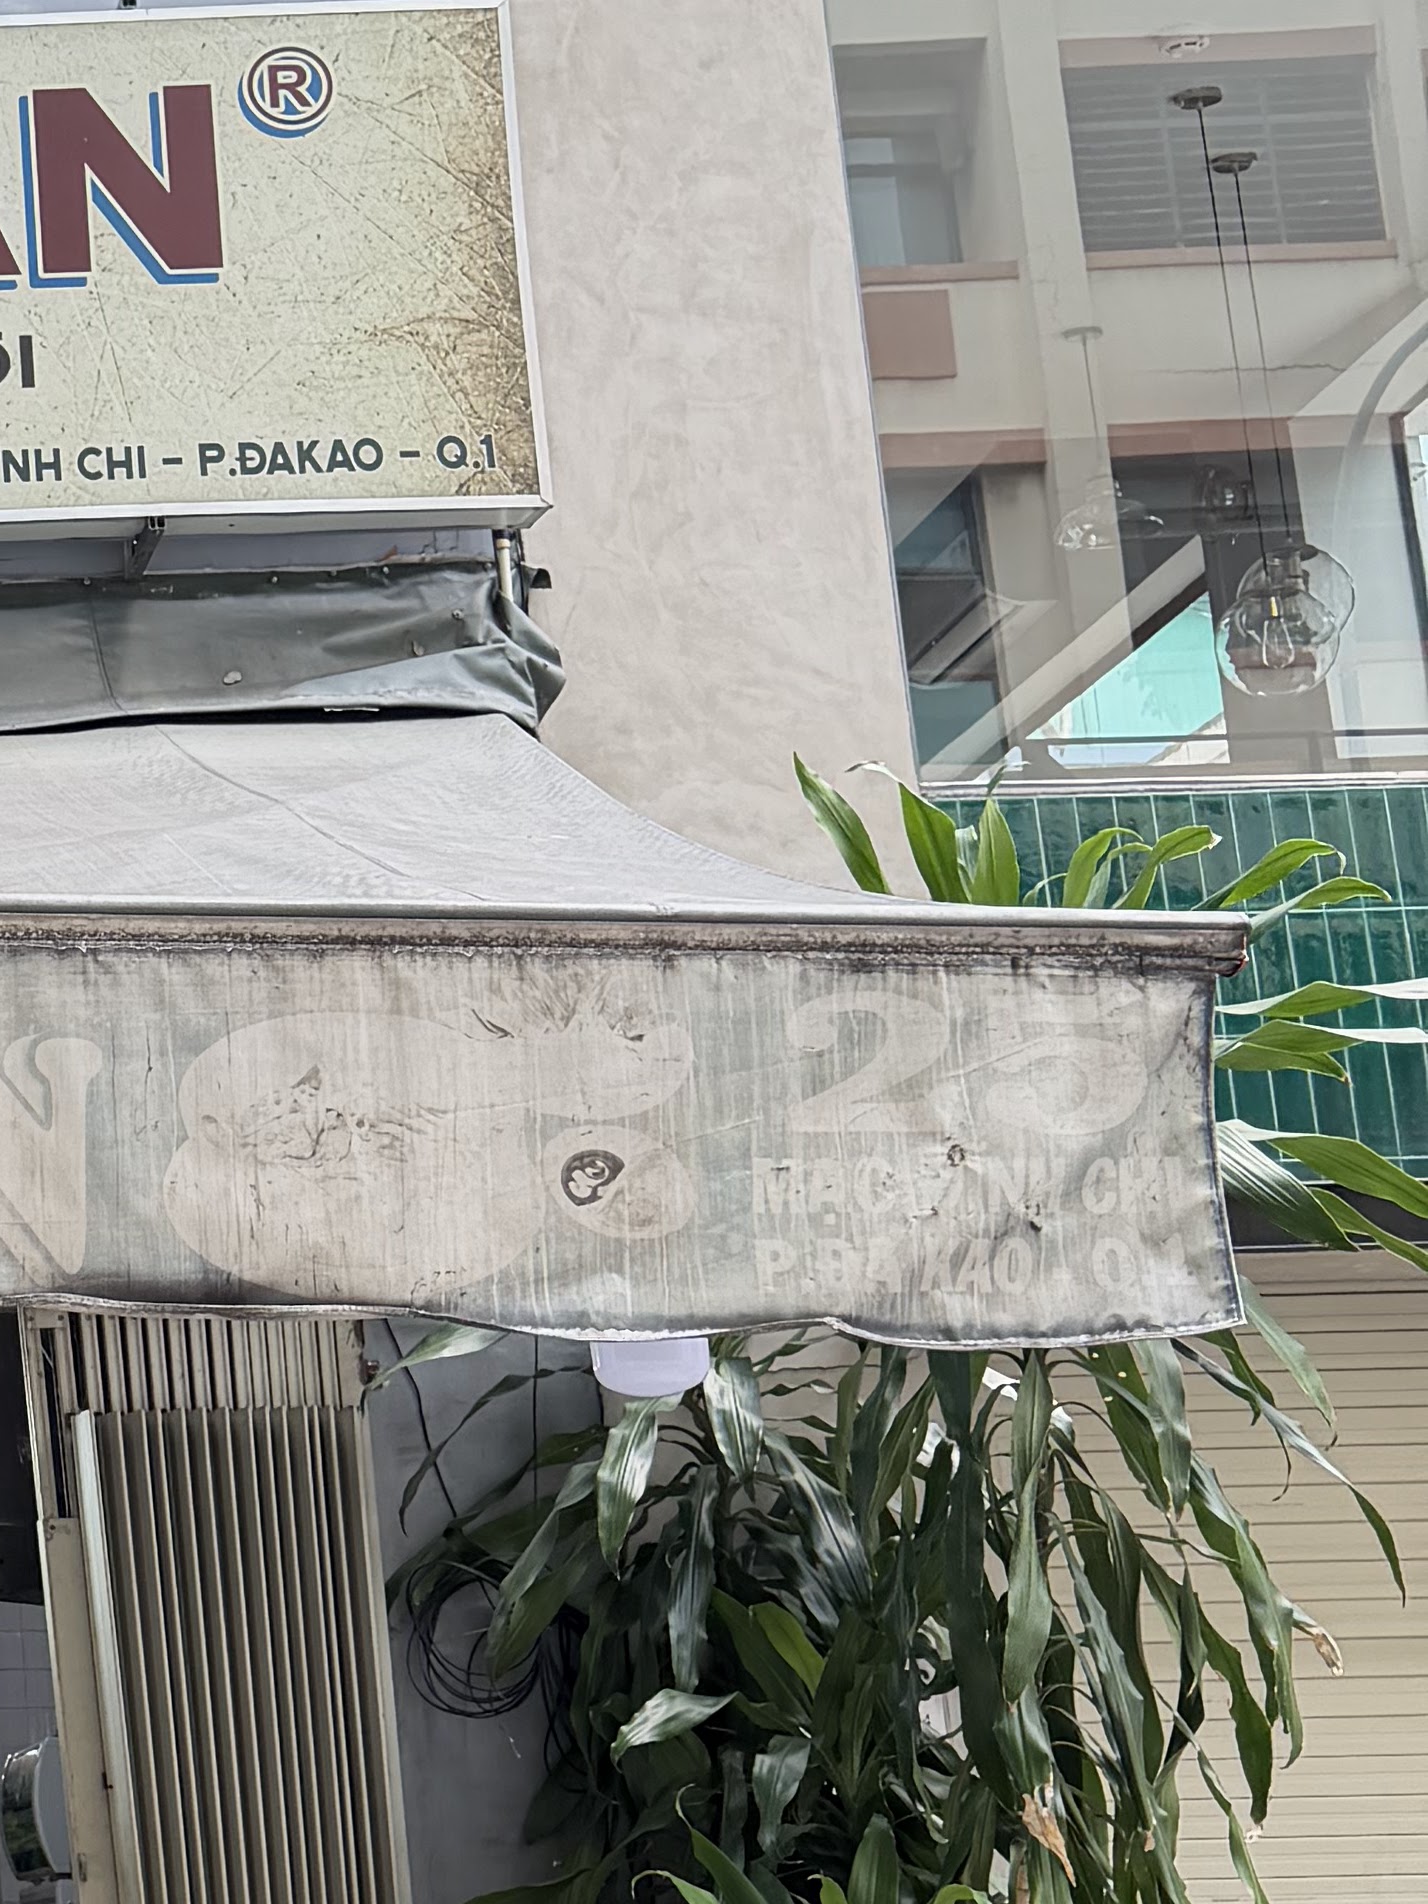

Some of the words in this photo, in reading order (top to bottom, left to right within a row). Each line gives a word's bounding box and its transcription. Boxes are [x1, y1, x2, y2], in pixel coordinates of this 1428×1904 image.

[76, 444, 147, 482] CHI
[197, 437, 385, 478] P.ĐAKAO
[435, 433, 497, 471] Q.1
